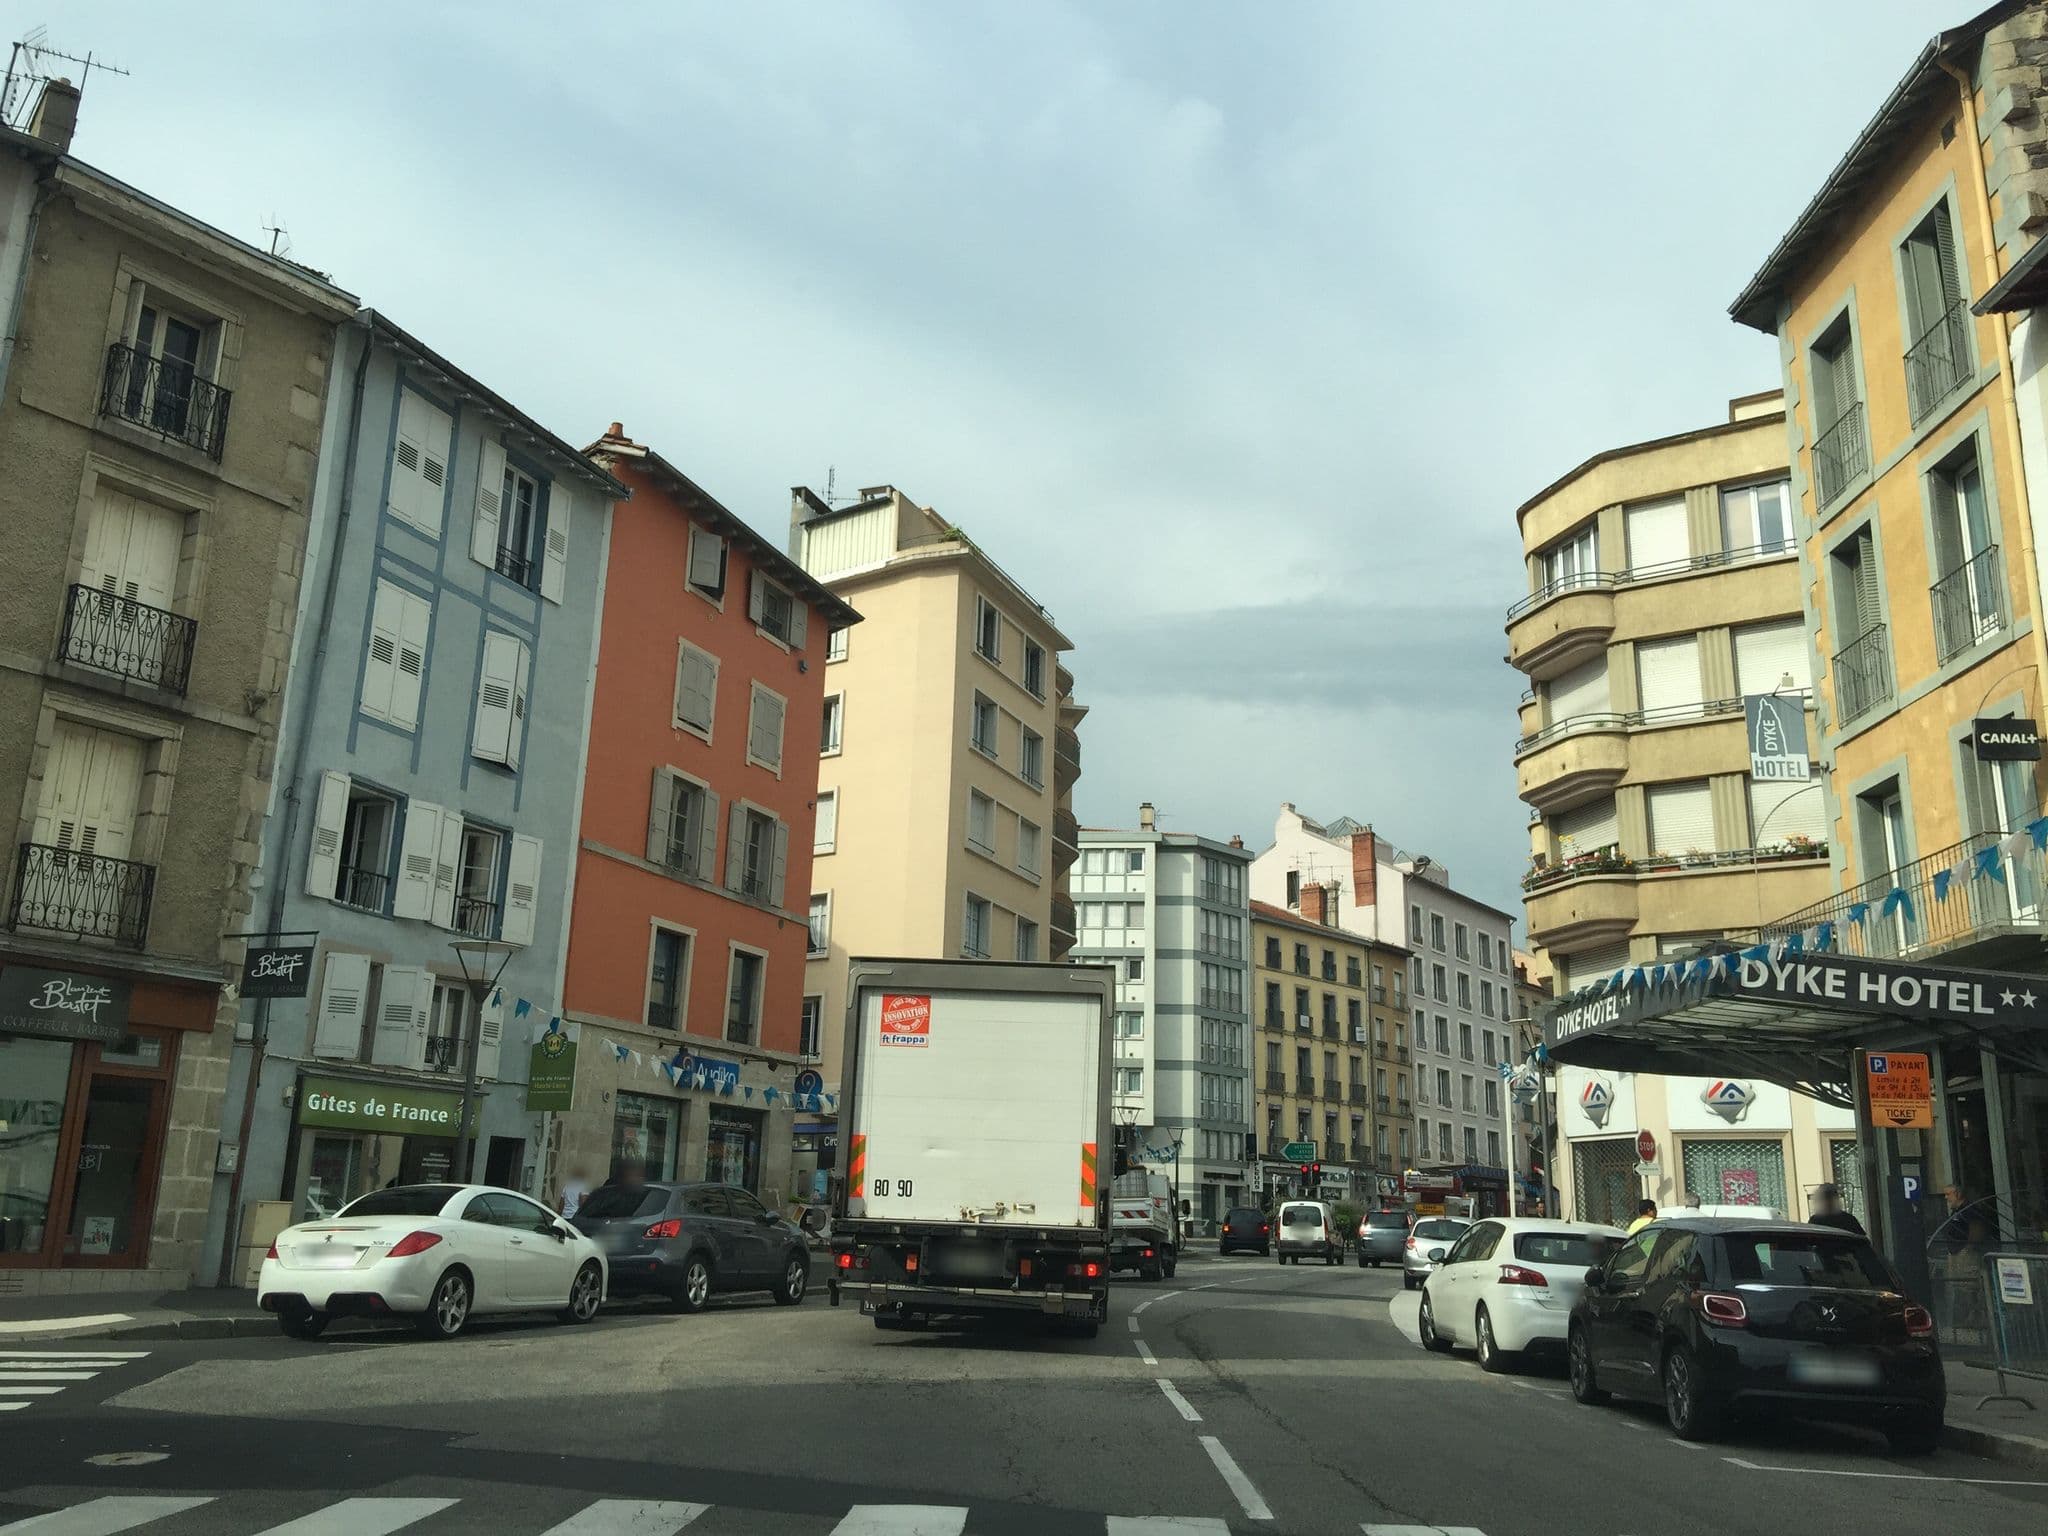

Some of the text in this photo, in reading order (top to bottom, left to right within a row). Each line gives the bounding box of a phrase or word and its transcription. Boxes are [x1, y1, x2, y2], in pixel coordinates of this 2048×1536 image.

[1763, 720, 1777, 751] DYKE
[1980, 732, 2037, 744] CANAL+
[1754, 760, 1807, 777] HOTEL
[1740, 959, 1995, 1015] DYKE HOTEL
[884, 1005, 928, 1022] INNOVATION
[1556, 995, 1619, 1040] DYKE HOTEL
[882, 1034, 925, 1044] ft frappa
[1891, 1061, 1925, 1069] PAYANT
[363, 1098, 386, 1117] de
[392, 1103, 449, 1123] France
[1886, 1109, 1917, 1117] TICKET
[1640, 1143, 1655, 1151] STOP
[874, 1179, 913, 1197] 80 90
[1903, 1177, 1917, 1199] P
